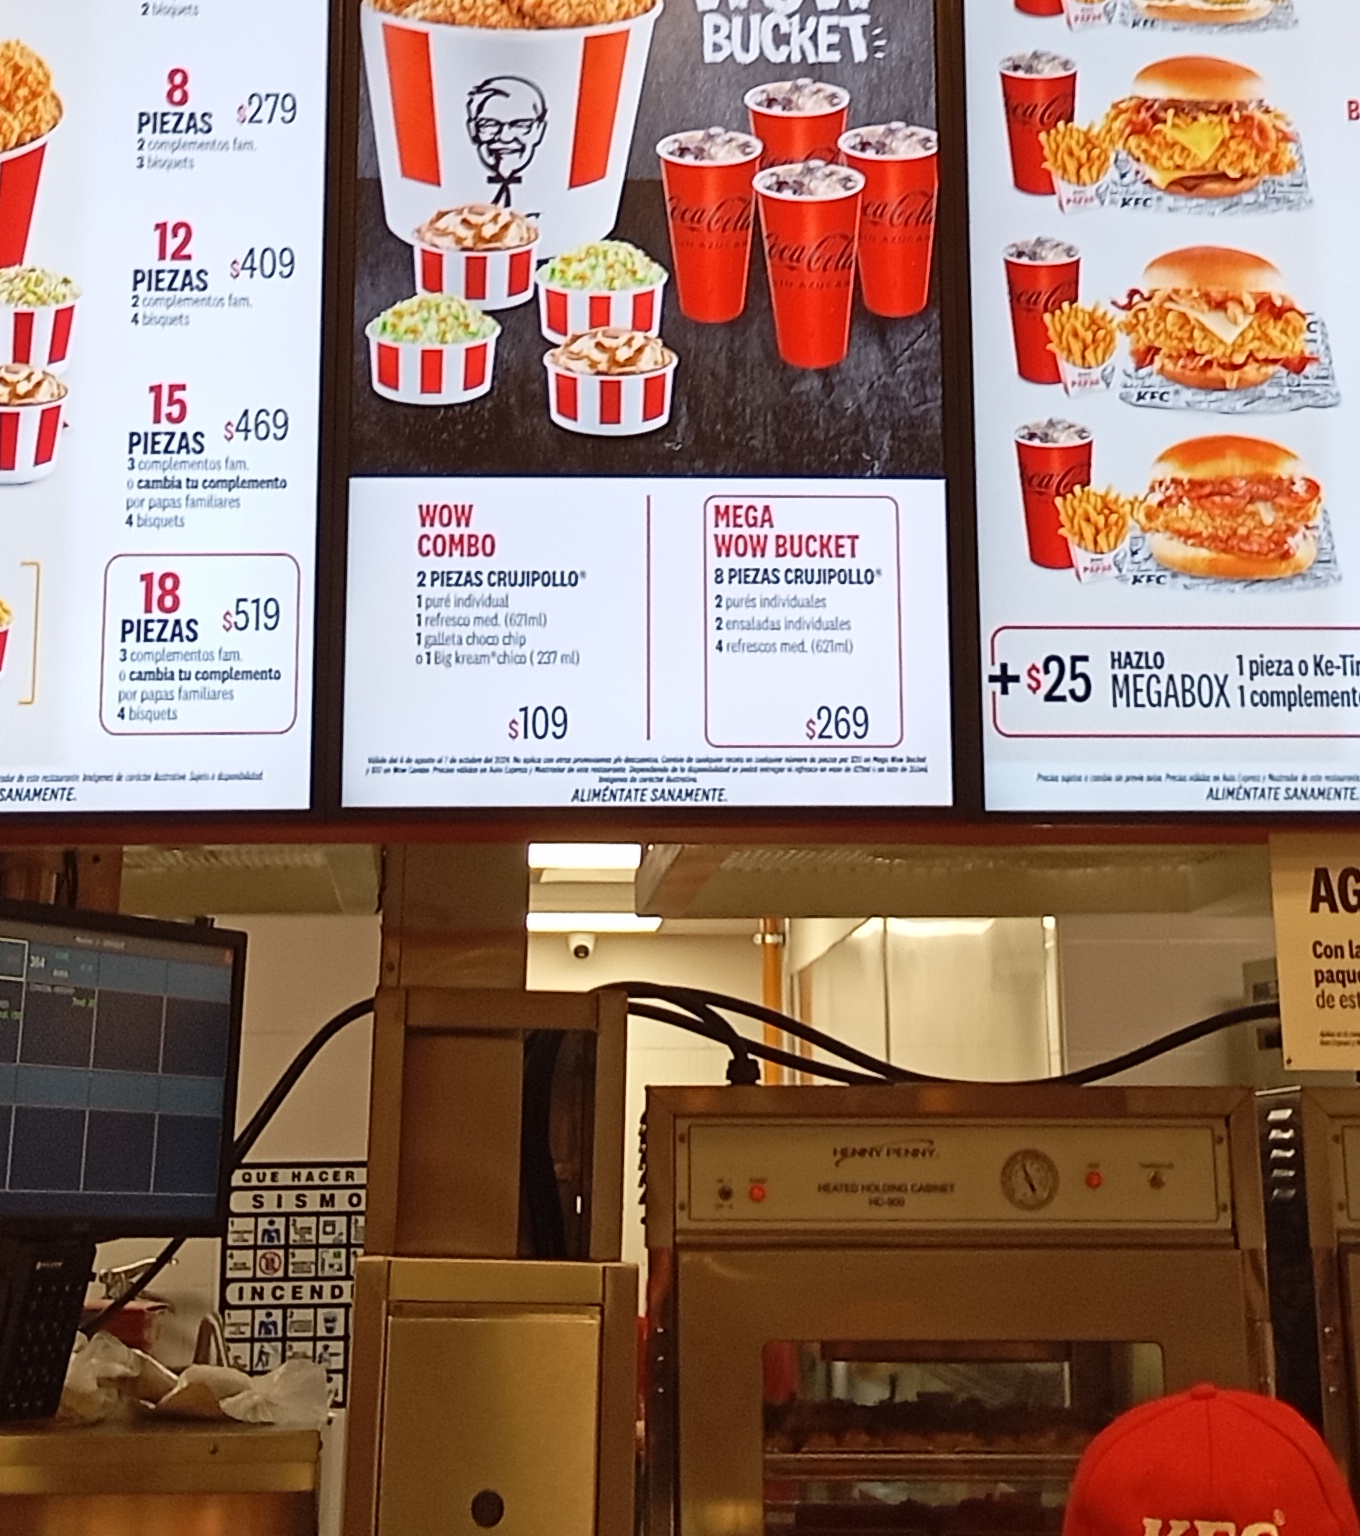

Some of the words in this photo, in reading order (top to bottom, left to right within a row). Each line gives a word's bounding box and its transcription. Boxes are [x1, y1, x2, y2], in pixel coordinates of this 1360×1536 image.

[703, 12, 870, 63] BUCKET
[165, 68, 189, 106] 8
[237, 93, 297, 124] $279
[137, 112, 212, 134] PIEZAS
[153, 221, 193, 261] 12
[229, 247, 295, 279] $409
[132, 269, 208, 291] PIEZAS
[149, 383, 188, 424] 15
[223, 409, 289, 441] $469
[127, 431, 205, 454] PIEZAS
[418, 504, 473, 527] WOW
[714, 505, 774, 527] MEGA
[418, 535, 495, 557] COMBO
[714, 535, 771, 558] WOW
[775, 535, 859, 558] BUCKET
[430, 571, 484, 588] PIEZAS
[728, 568, 780, 585] PIEZAS
[140, 572, 180, 614] 18
[222, 597, 280, 632] $519
[120, 618, 199, 643] PIEZAS
[1110, 651, 1164, 670] HAZLO
[1248, 654, 1295, 681] pieza
[129, 667, 175, 682] cambia
[195, 668, 281, 684] complemento
[1027, 655, 1092, 702] $25
[1111, 674, 1230, 708] MEGABOX
[508, 706, 568, 739] $109
[806, 706, 870, 739] $269
[1312, 941, 1345, 960] Con
[242, 1171, 280, 1183] QUE
[291, 1170, 355, 1182] HACER
[252, 1192, 362, 1209] SISMO
